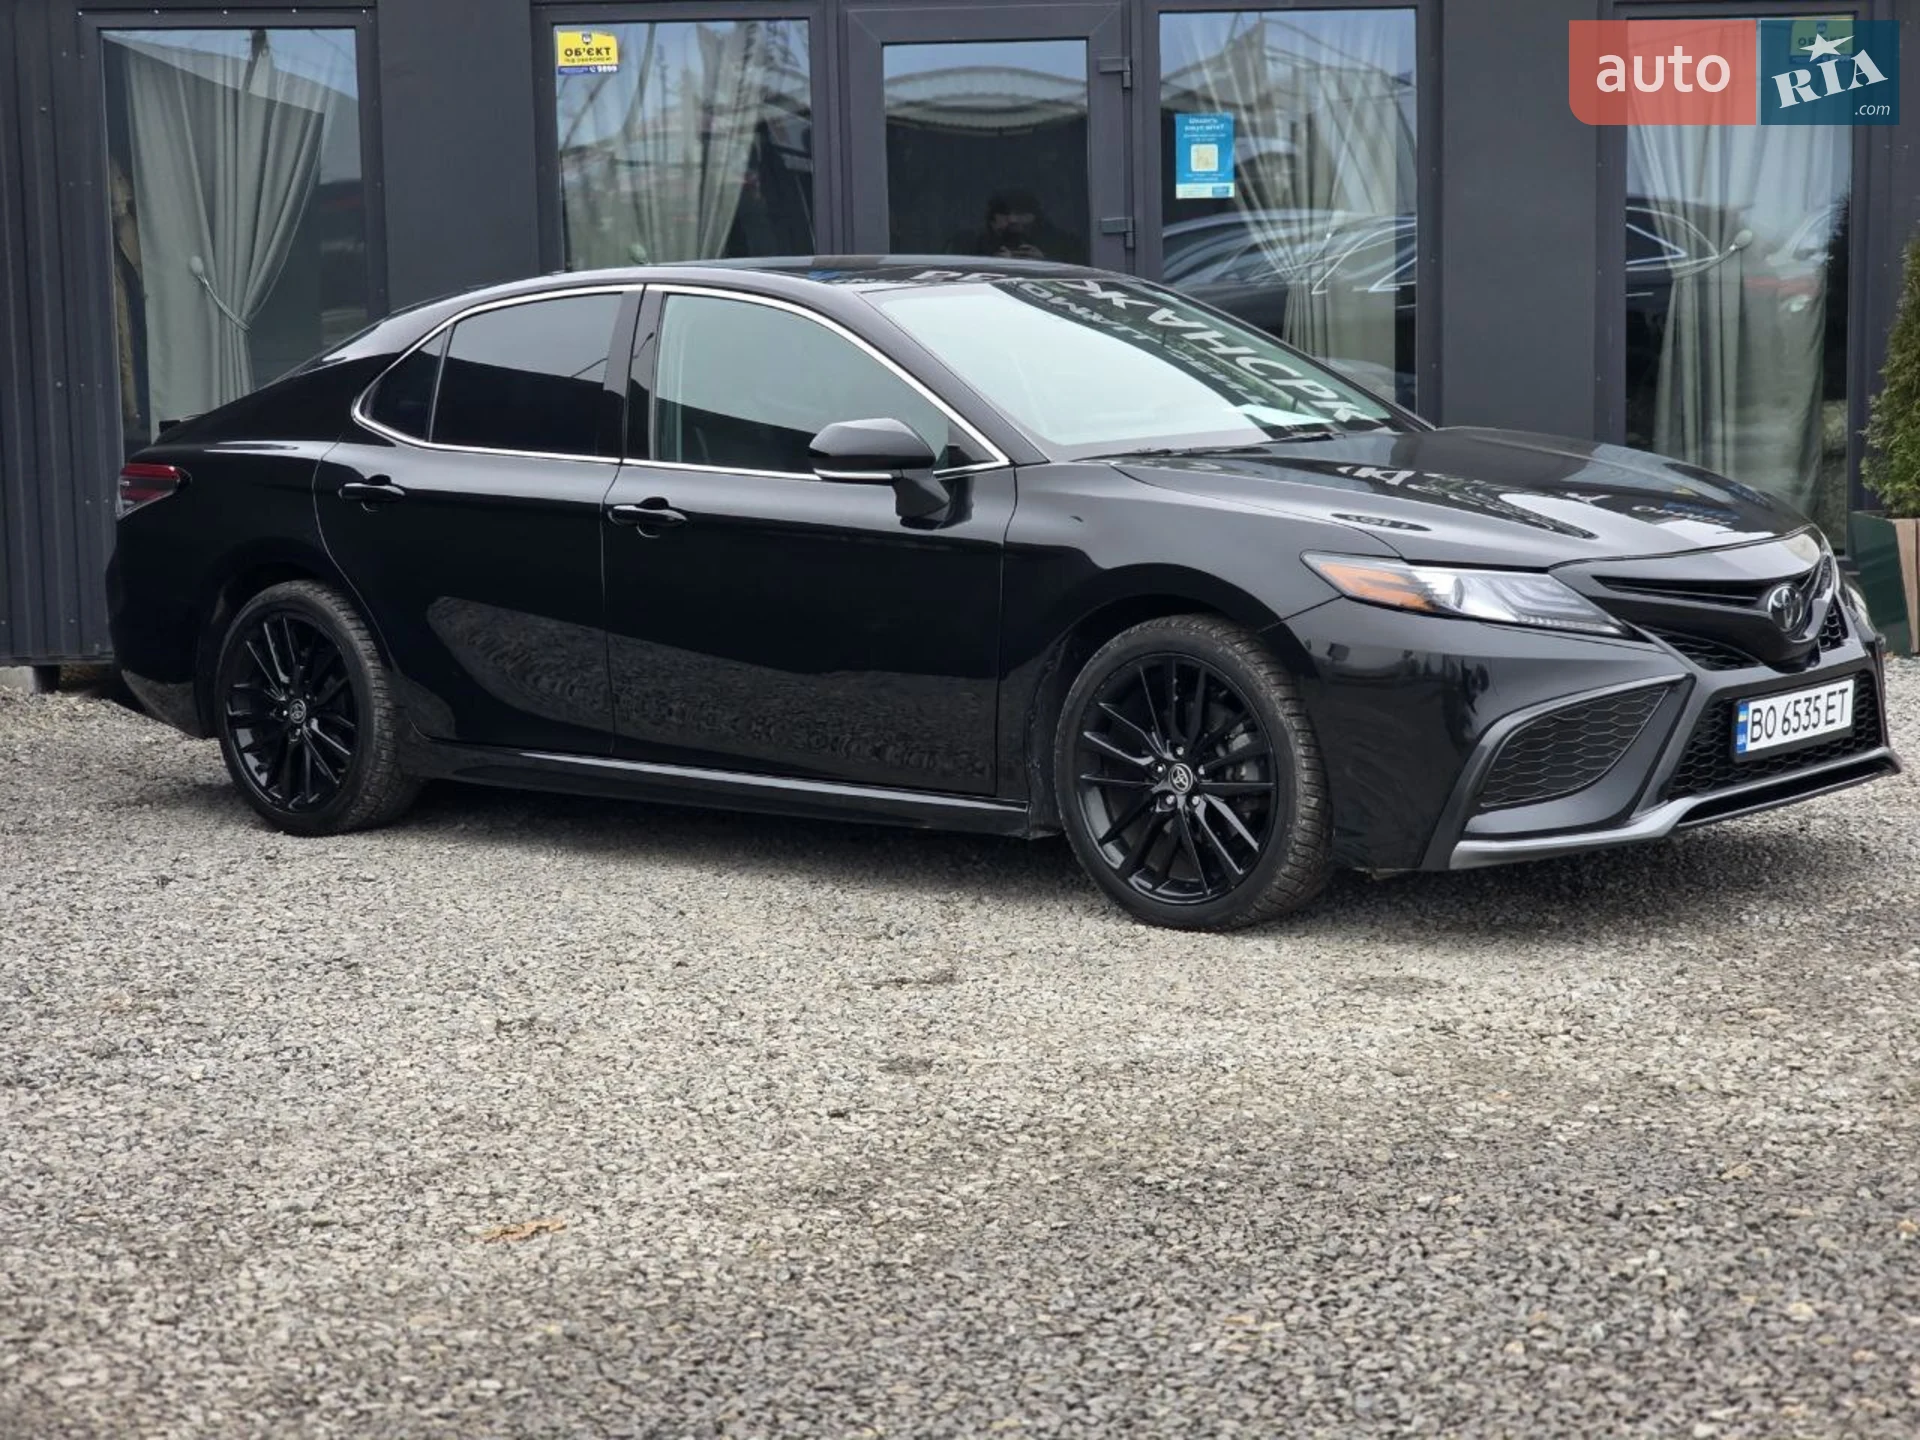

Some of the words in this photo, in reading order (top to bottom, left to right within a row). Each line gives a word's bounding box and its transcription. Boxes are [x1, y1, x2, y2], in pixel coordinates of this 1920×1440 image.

[1750, 704, 1777, 743] BO
[1781, 694, 1822, 736] 6535
[1824, 688, 1849, 726] ET
